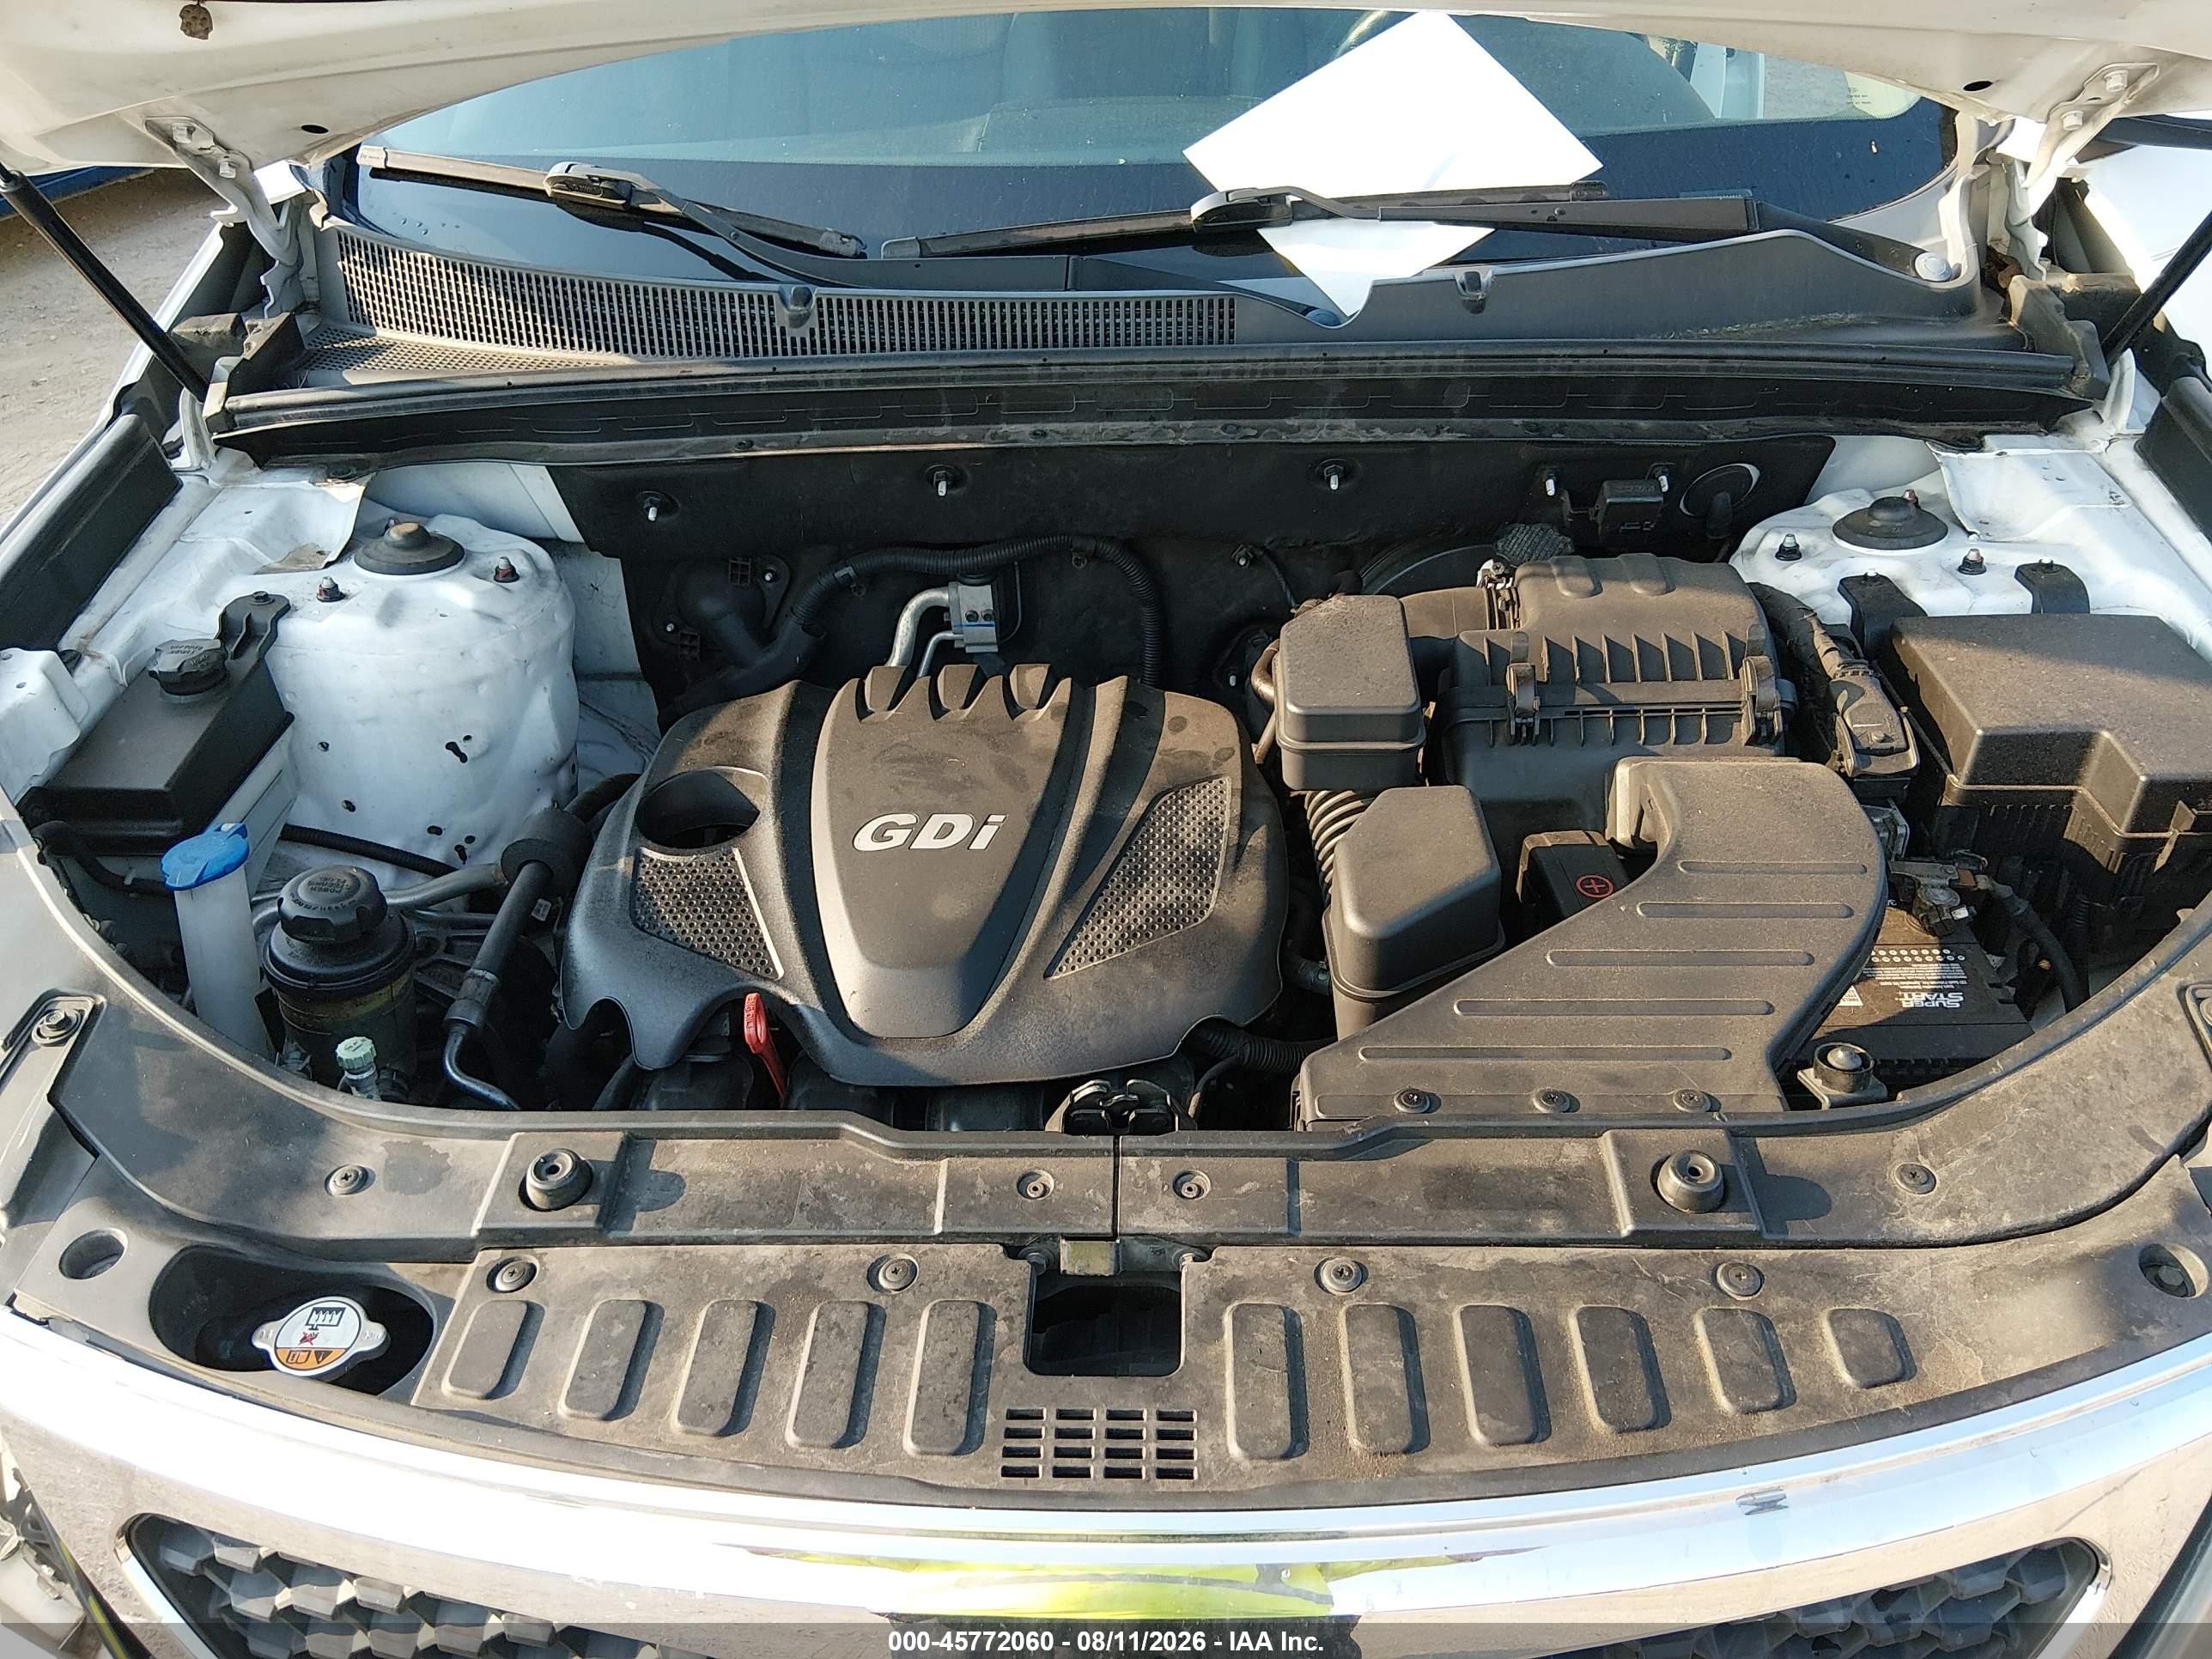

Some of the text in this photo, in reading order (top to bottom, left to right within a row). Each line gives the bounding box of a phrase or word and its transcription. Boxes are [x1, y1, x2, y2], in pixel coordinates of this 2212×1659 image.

[852, 812, 1009, 852] GDi
[1900, 991, 1964, 1002] START
[1901, 1000, 1961, 1009] SUPER
